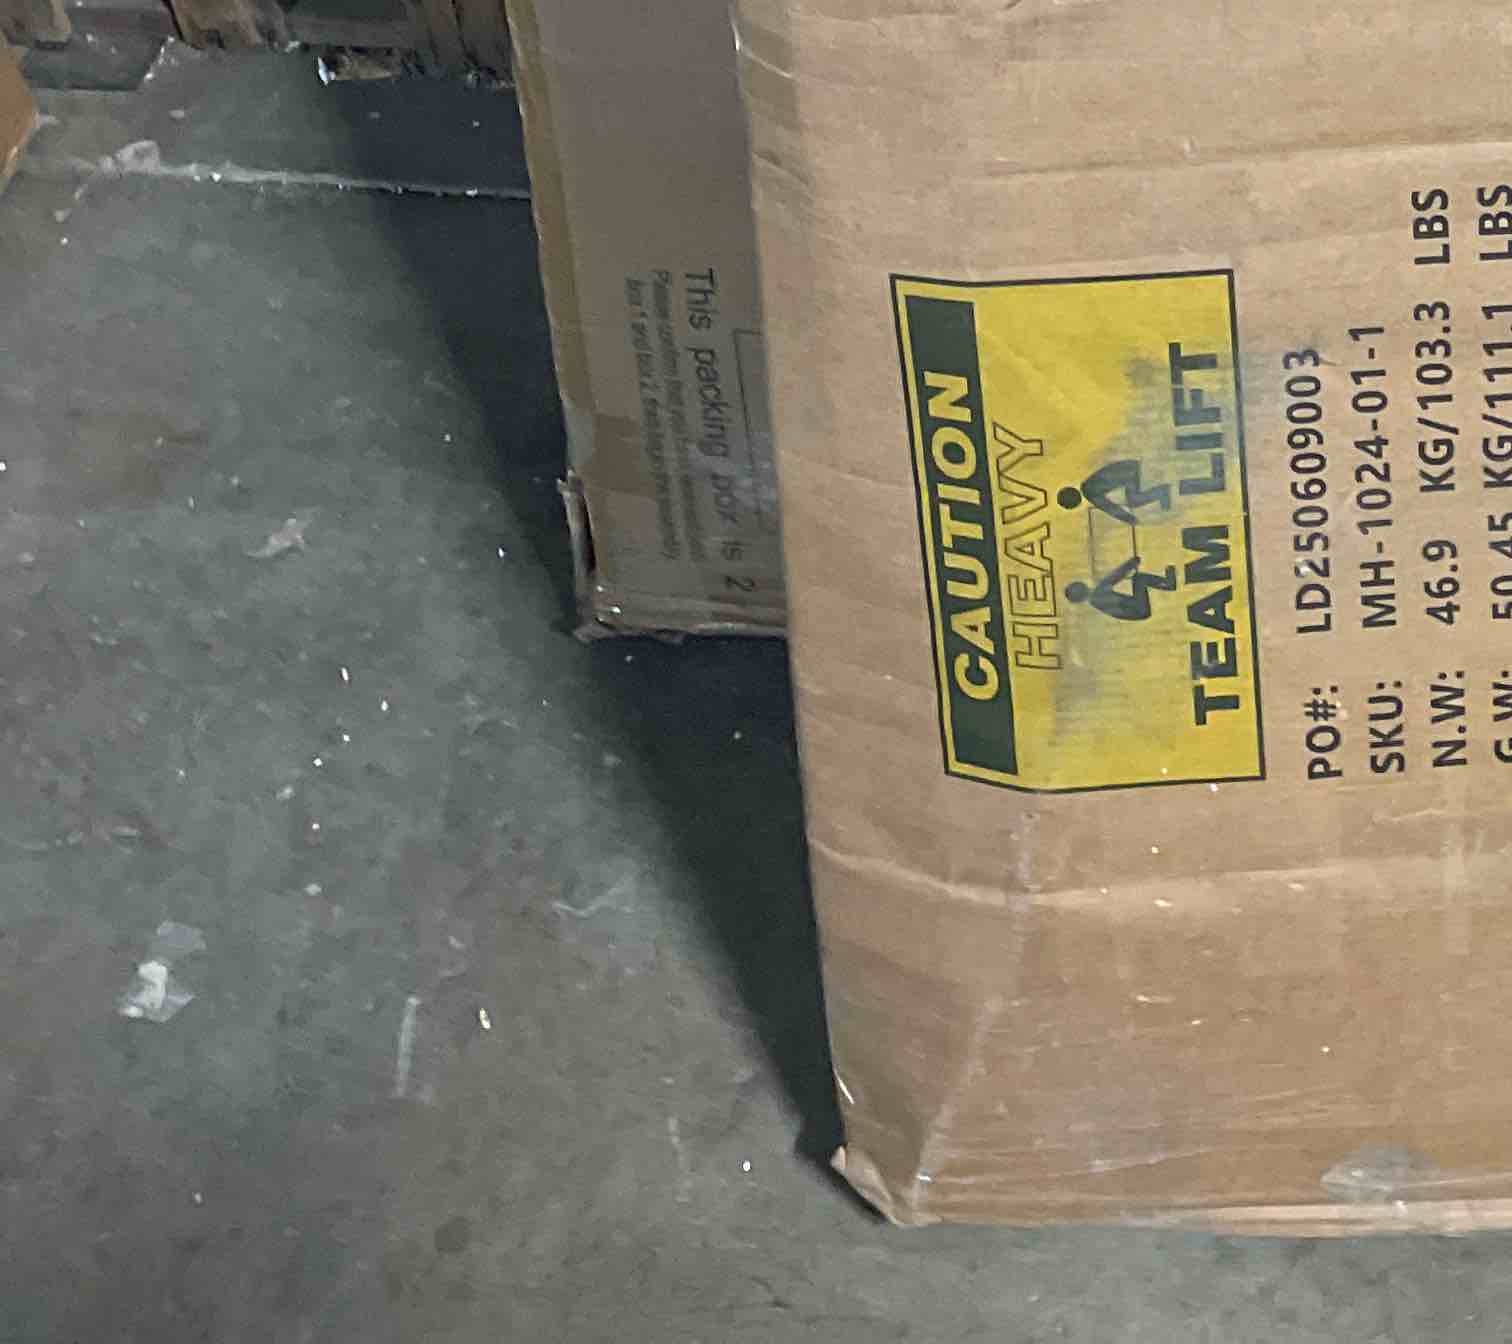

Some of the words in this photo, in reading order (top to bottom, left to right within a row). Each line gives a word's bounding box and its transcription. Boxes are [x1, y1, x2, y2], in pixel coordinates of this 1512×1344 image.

[1411, 187, 1450, 265] LBS
[685, 267, 719, 330] This
[686, 346, 729, 458] packing
[1168, 341, 1226, 496] LIFT
[1414, 300, 1460, 494] KG/103.3
[924, 371, 999, 702] CAUTION
[1283, 348, 1332, 634] LD250609003
[1348, 326, 1397, 628] MH-1024-01-1
[992, 421, 1064, 671] HEAVY
[1422, 539, 1461, 626] 46.9
[1181, 524, 1240, 726] TEAM
[1307, 684, 1344, 780] PO#:
[1370, 680, 1405, 773] SKU:
[1431, 669, 1468, 768] N.W:
